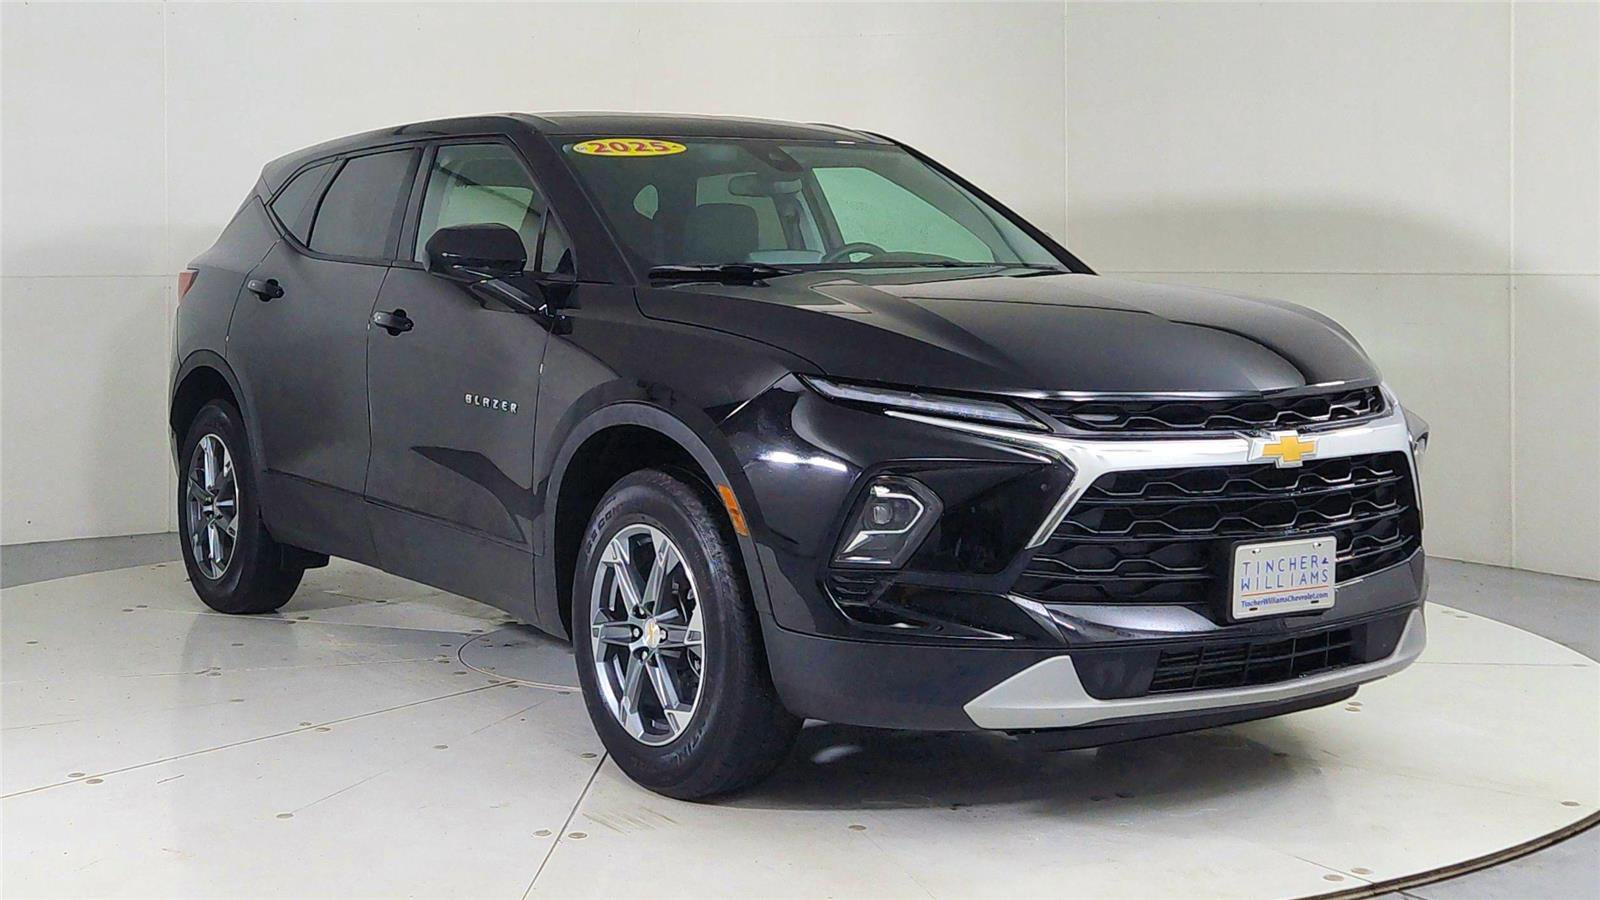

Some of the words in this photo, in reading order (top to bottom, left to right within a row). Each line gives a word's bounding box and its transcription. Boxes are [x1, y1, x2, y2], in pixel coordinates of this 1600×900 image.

[587, 141, 671, 153] 2025
[465, 393, 517, 414] BLAZER
[1242, 554, 1319, 576] TINCHER
[1240, 568, 1329, 591] WILLIAMS
[1241, 591, 1329, 608] TincherWilliamsChevrolet.com
